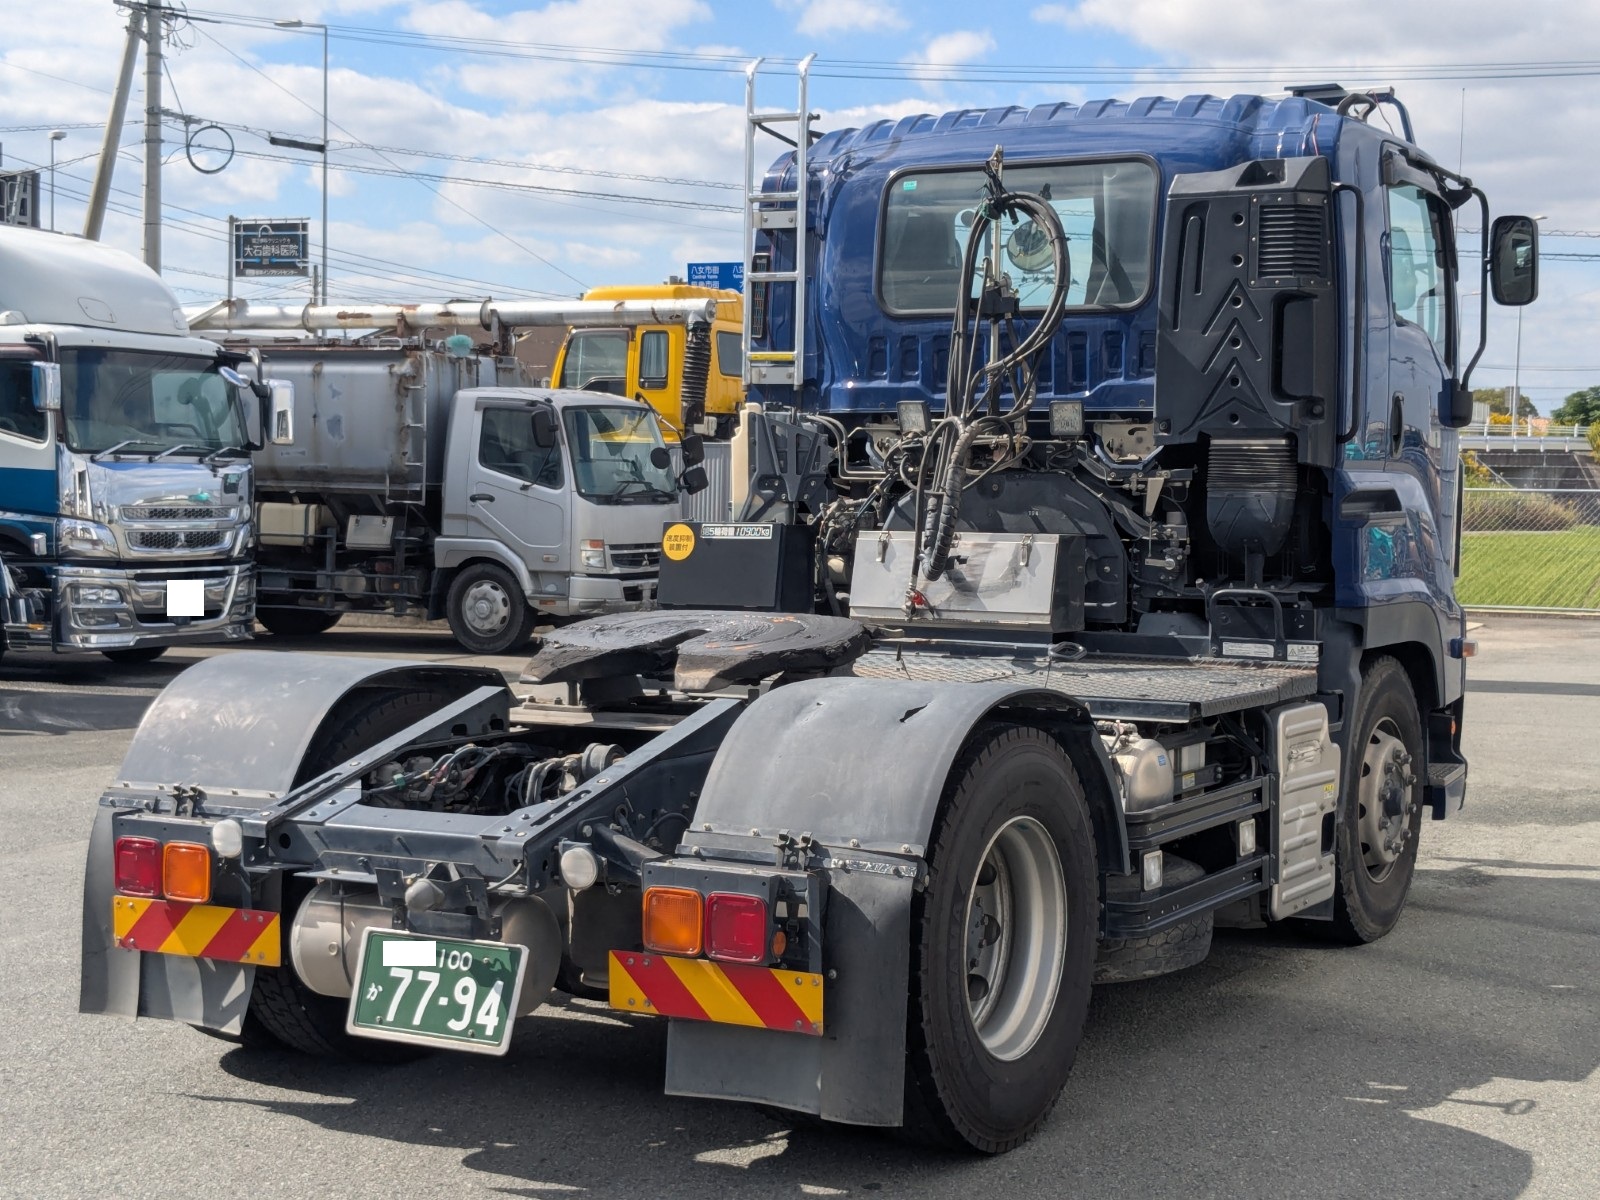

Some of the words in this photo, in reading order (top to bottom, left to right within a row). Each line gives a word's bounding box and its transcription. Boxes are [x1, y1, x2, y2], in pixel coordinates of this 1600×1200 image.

[244, 244, 298, 256] 大石歯科医院
[439, 948, 473, 971] 100
[366, 982, 383, 1001] か
[386, 967, 504, 1036] 77-94
